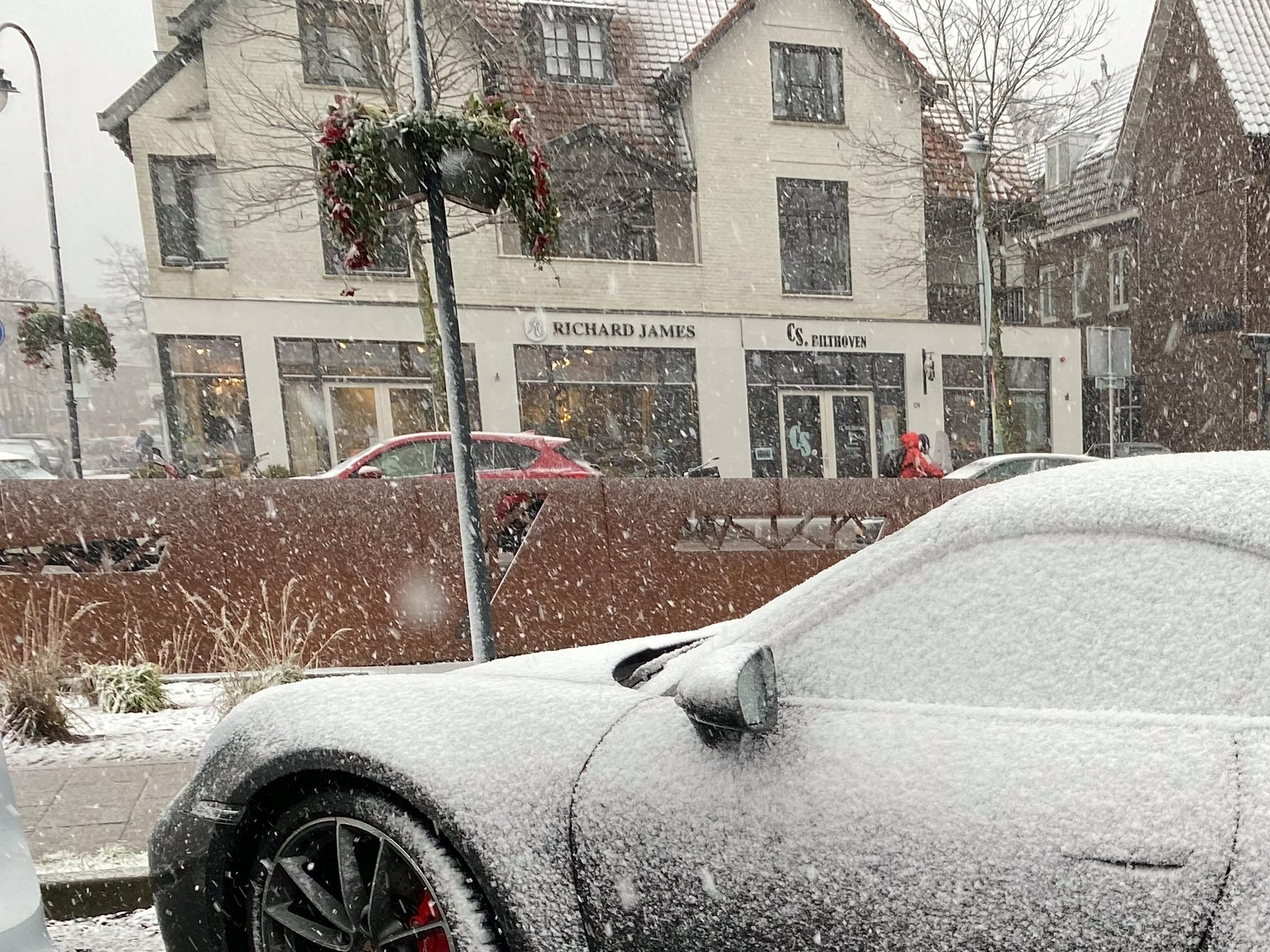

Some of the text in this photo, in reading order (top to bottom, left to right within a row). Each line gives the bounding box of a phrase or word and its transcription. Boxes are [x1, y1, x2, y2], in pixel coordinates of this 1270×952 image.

[553, 322, 696, 338] RICHARD JAMES
[811, 334, 867, 349] BILTHOVEN
